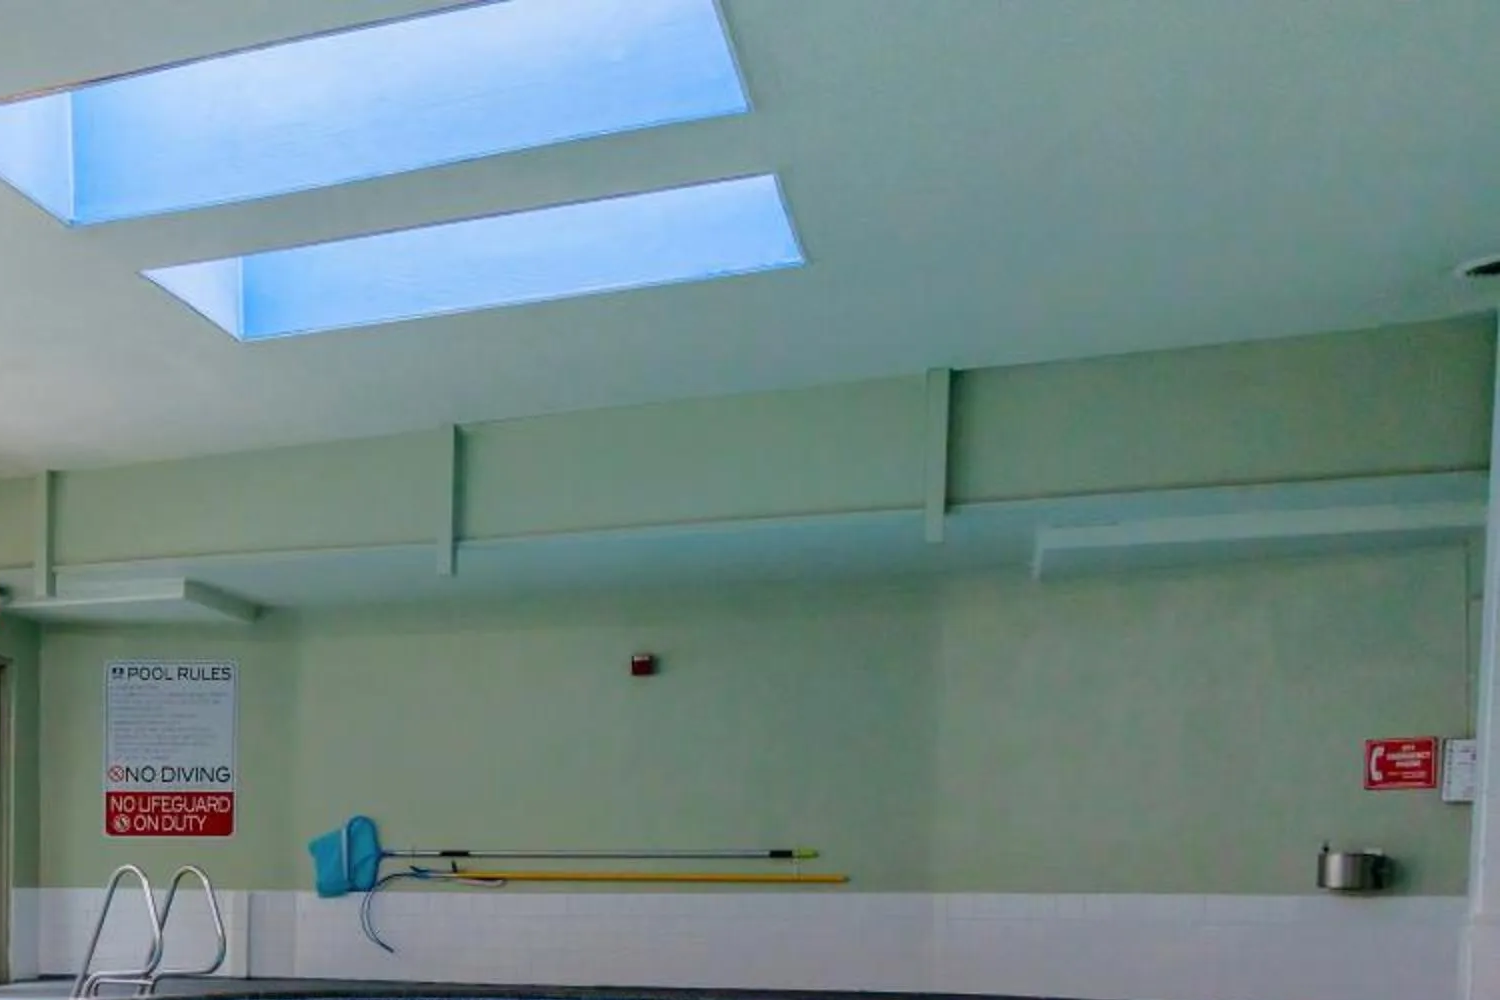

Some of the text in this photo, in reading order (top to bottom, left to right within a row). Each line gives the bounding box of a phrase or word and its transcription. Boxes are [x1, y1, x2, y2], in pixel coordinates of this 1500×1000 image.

[127, 667, 231, 681] POOL RULES
[125, 765, 231, 783] NO DIVING
[111, 795, 231, 813] NO LIFEGUARD
[133, 815, 207, 832] ON DUTY
